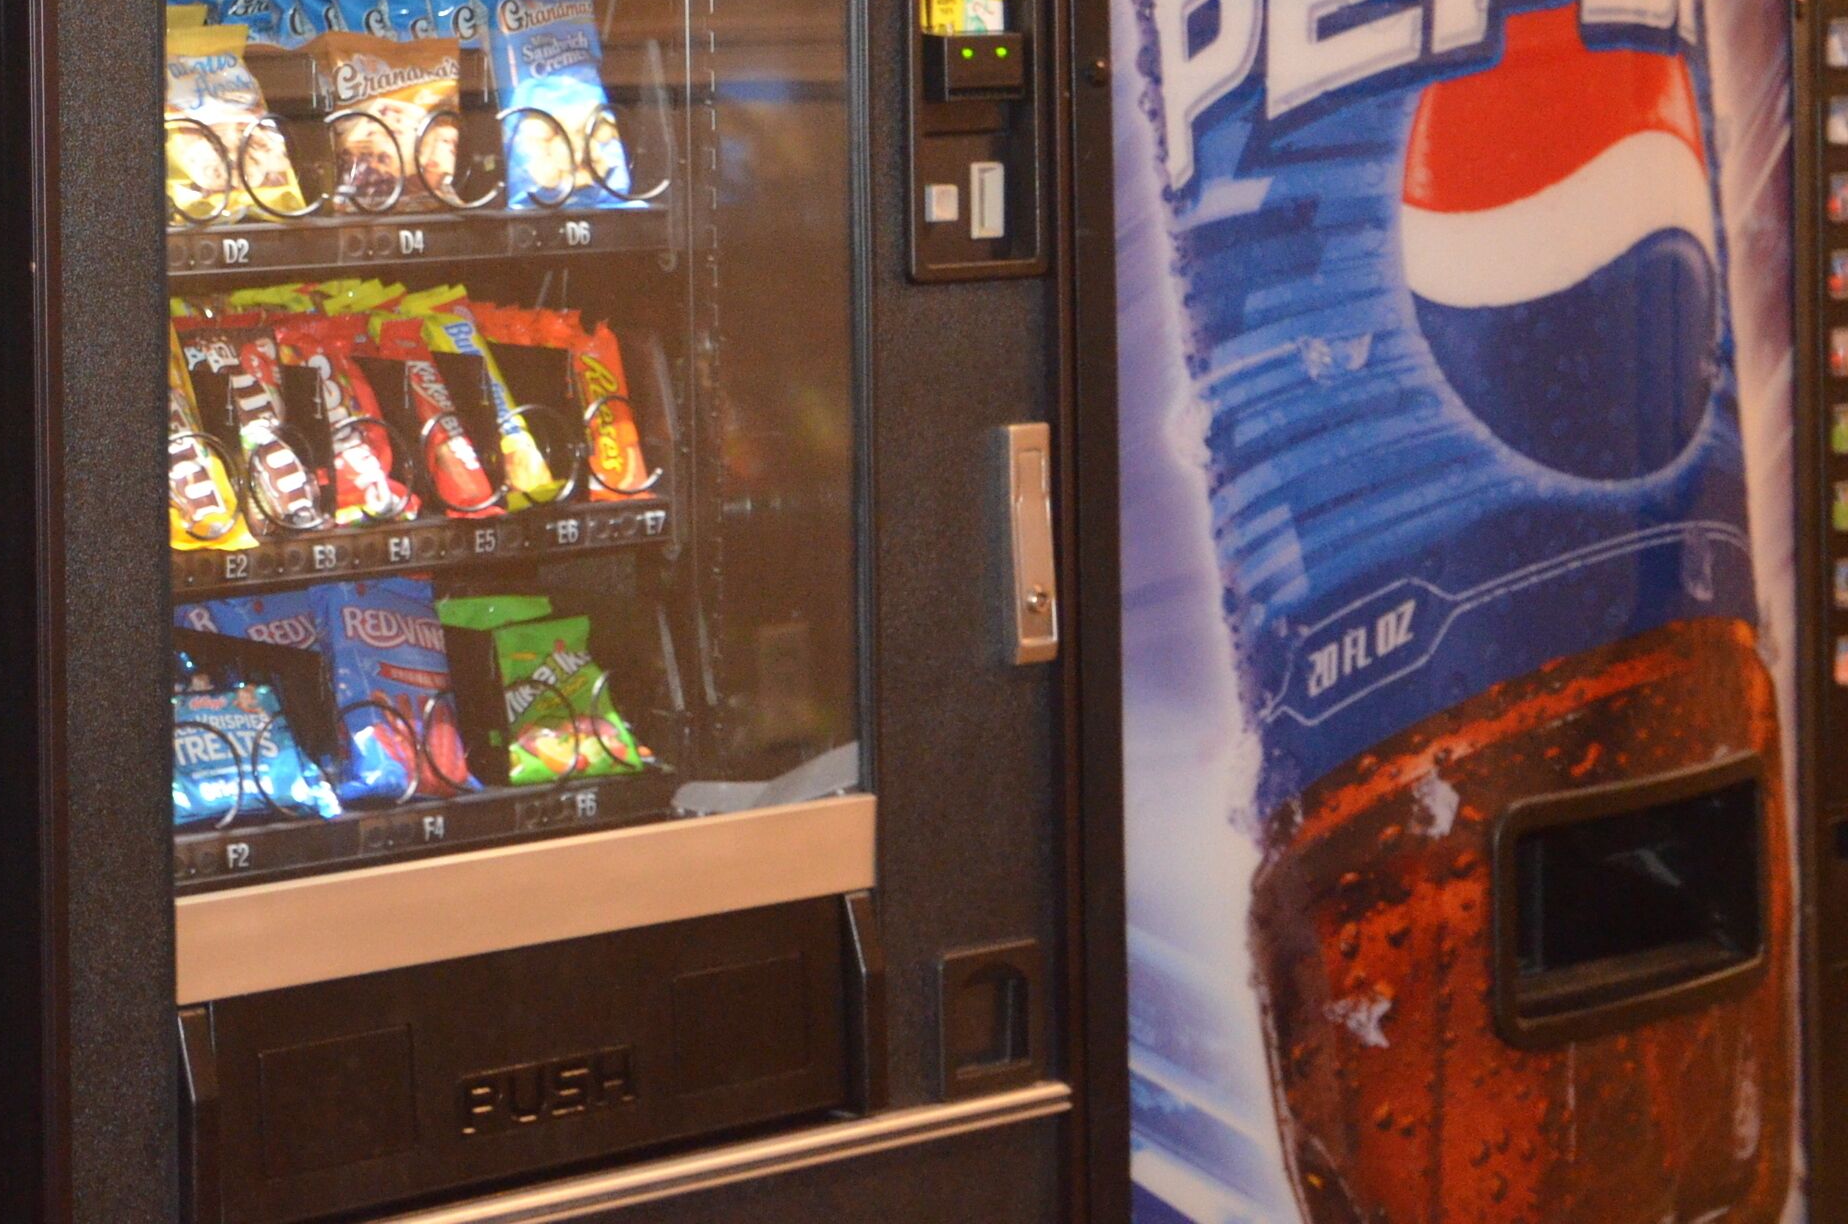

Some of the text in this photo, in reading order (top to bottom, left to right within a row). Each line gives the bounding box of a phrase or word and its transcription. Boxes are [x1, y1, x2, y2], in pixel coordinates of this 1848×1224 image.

[523, 31, 589, 61] Sandwich
[399, 229, 425, 255] D4
[566, 220, 591, 246] D6
[223, 239, 249, 264] D2
[558, 520, 579, 544] E6
[645, 511, 666, 536] E7
[389, 537, 412, 562] E4
[475, 529, 497, 554] E5
[226, 555, 249, 579] E2
[314, 545, 337, 569] E3
[342, 606, 447, 653] RED VIN
[1307, 599, 1417, 698] 20 FL OZ
[172, 730, 279, 767] TREATS
[576, 793, 598, 818] F6
[423, 816, 445, 840] F4
[227, 844, 250, 868] F2
[462, 1047, 637, 1135] PUSH
